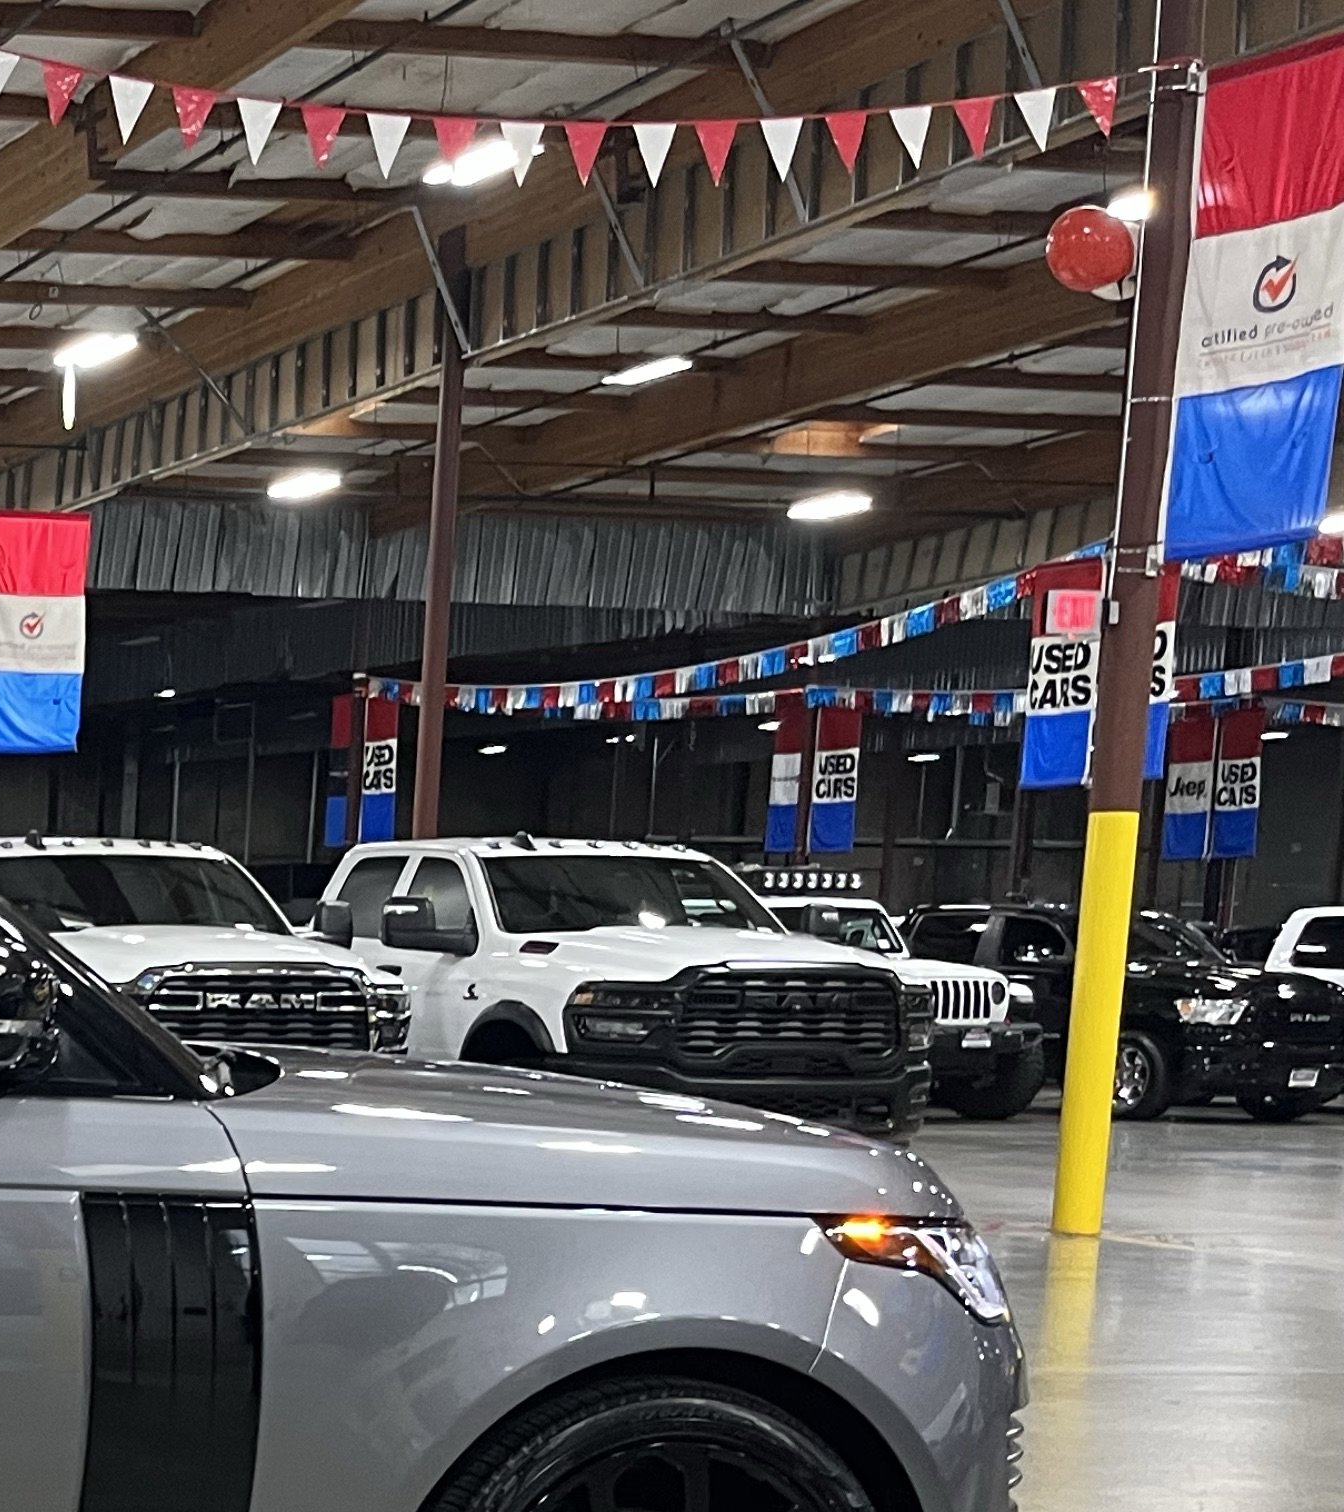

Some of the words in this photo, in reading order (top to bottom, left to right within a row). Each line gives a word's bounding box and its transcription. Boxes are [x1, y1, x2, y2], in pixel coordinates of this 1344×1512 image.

[1201, 324, 1258, 348] ctified
[1263, 302, 1334, 340] pre-owed
[1032, 643, 1091, 675] USED
[1030, 675, 1092, 710] CARS
[365, 745, 394, 767] UED
[819, 753, 856, 775] USED
[364, 768, 394, 790] CAS
[1221, 761, 1257, 784] USED
[205, 993, 315, 1009] RAM
